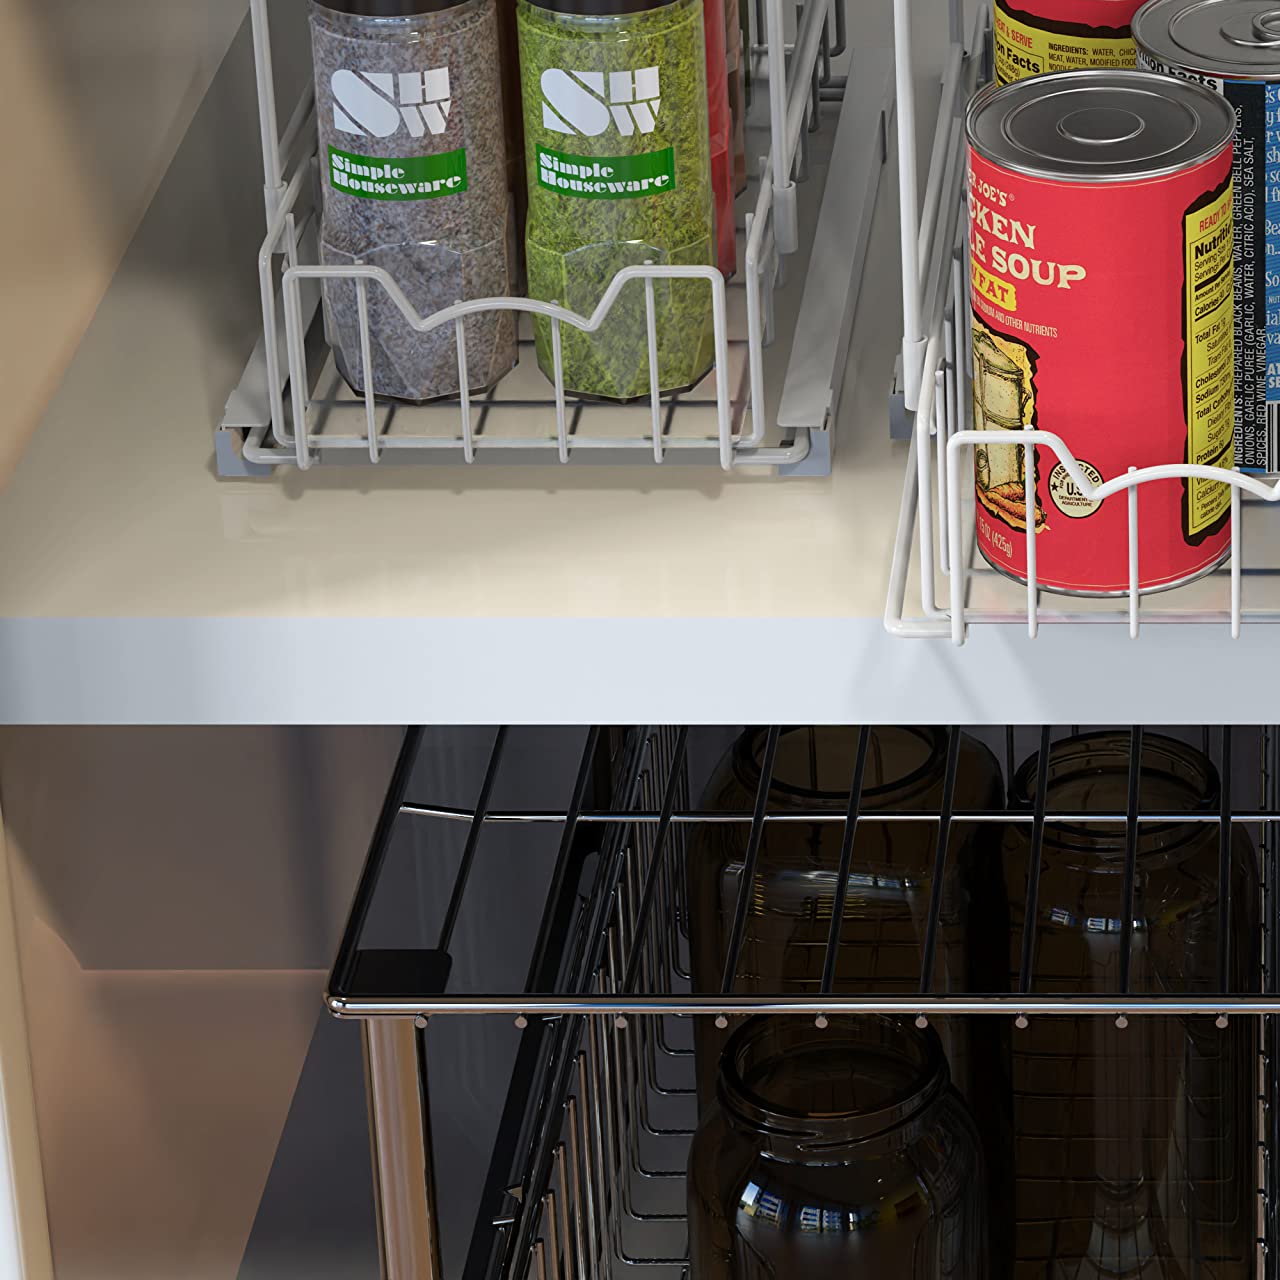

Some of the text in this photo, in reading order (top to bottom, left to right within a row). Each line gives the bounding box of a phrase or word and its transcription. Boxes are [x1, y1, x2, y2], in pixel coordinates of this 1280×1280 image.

[1011, 29, 1033, 49] SERVE
[1048, 42, 1116, 58] INGREDIENTS: WATER,
[1006, 47, 1041, 74] Facts
[1048, 52, 1120, 67] MEAT, WATER, MODIFIED
[331, 153, 406, 180] Simple
[539, 152, 615, 179] Simple
[333, 169, 463, 195] Houseware
[541, 169, 670, 195] Houseware
[991, 244, 1087, 290] SOUP
[978, 276, 1009, 304] FAT
[1244, 137, 1256, 465] ONIONS, GARLIC PUREE (GARLIC, WATER, CITRIC ACID), SEA SALT,
[1233, 157, 1244, 465] INGREDIENTS: PREPARED BLACK BEANS, WATER, GREEN BELL
[1005, 315, 1058, 339] OTHER NUTRIENTS
[1256, 374, 1266, 402] WINE
[1256, 405, 1266, 425] RED
[991, 531, 1013, 558] (425g)
